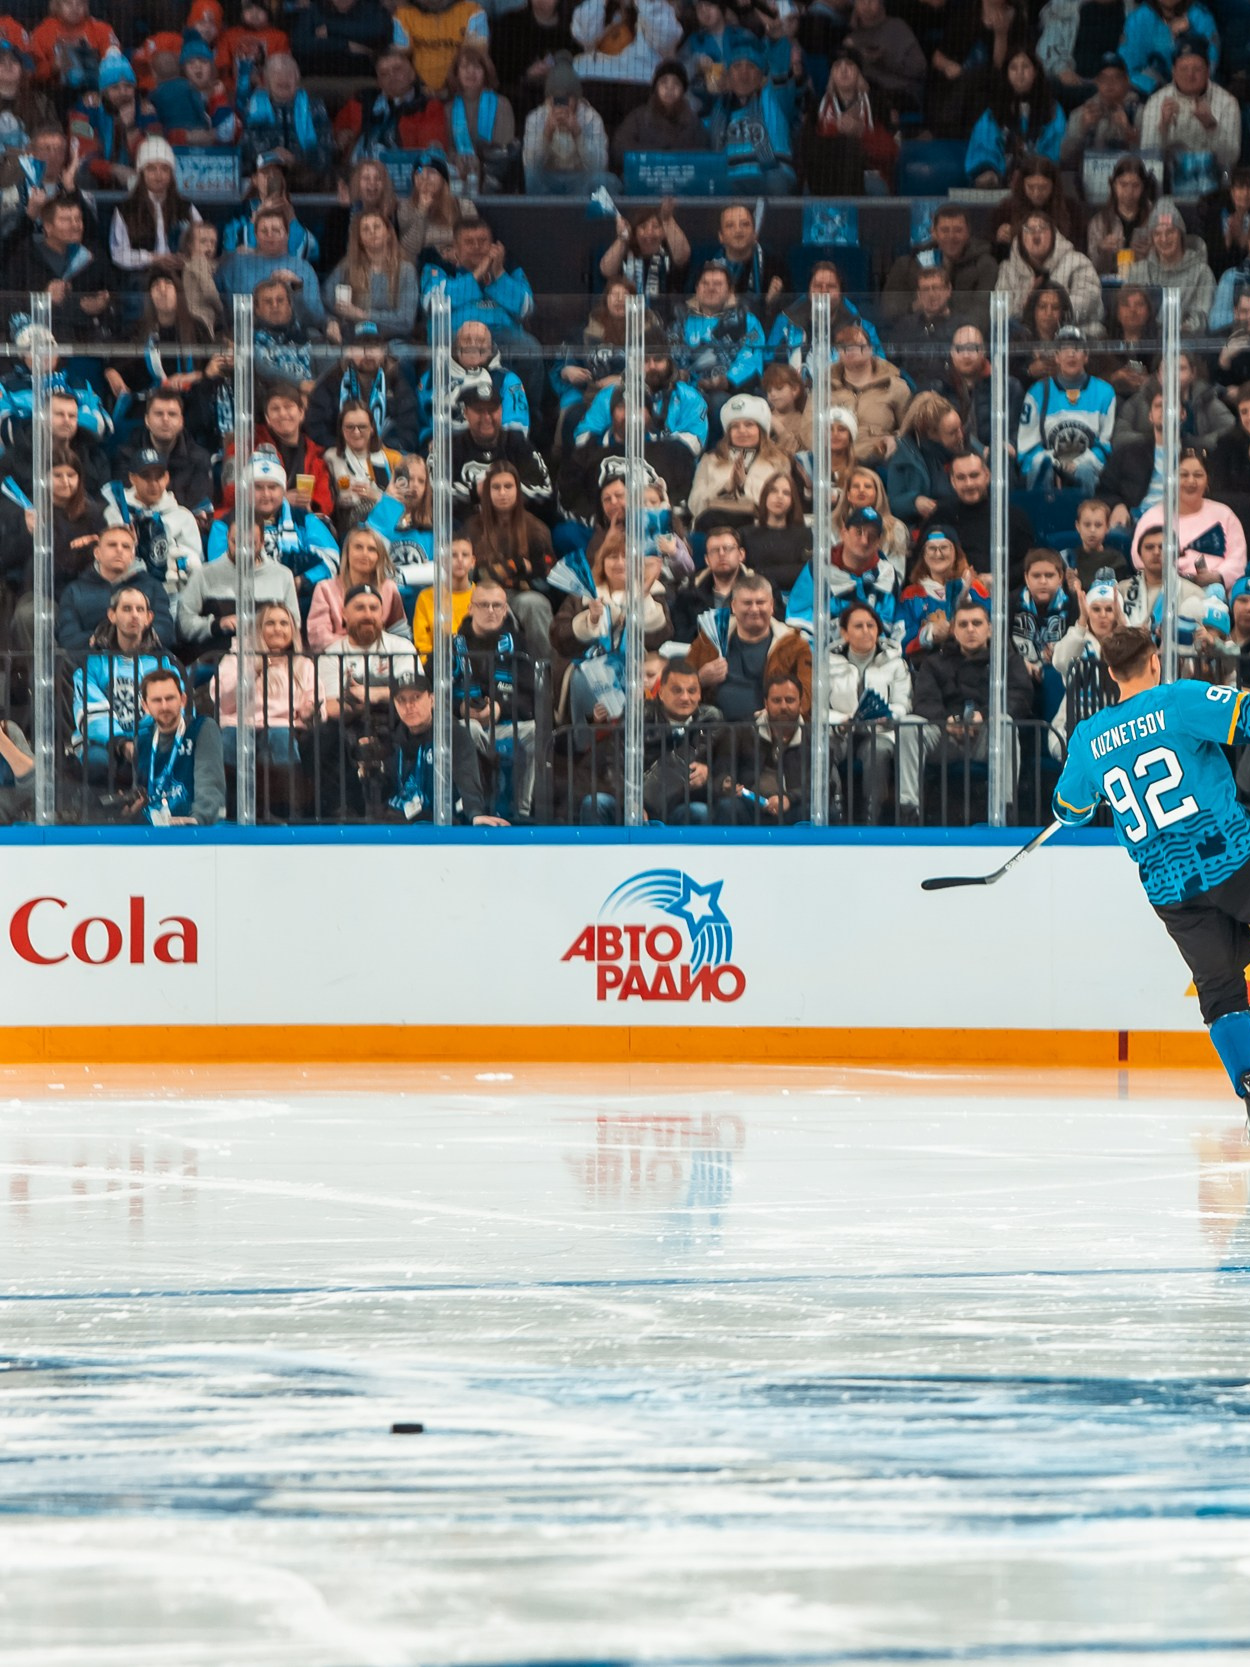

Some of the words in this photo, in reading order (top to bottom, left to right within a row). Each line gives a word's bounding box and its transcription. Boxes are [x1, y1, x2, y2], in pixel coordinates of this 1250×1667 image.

[1206, 685, 1239, 704] 9
[1090, 710, 1166, 760] KUZNETSOV
[1103, 746, 1199, 843] 92
[9, 896, 198, 965] Cola
[561, 925, 682, 962] АВТО
[597, 965, 746, 1003] РАДИО
